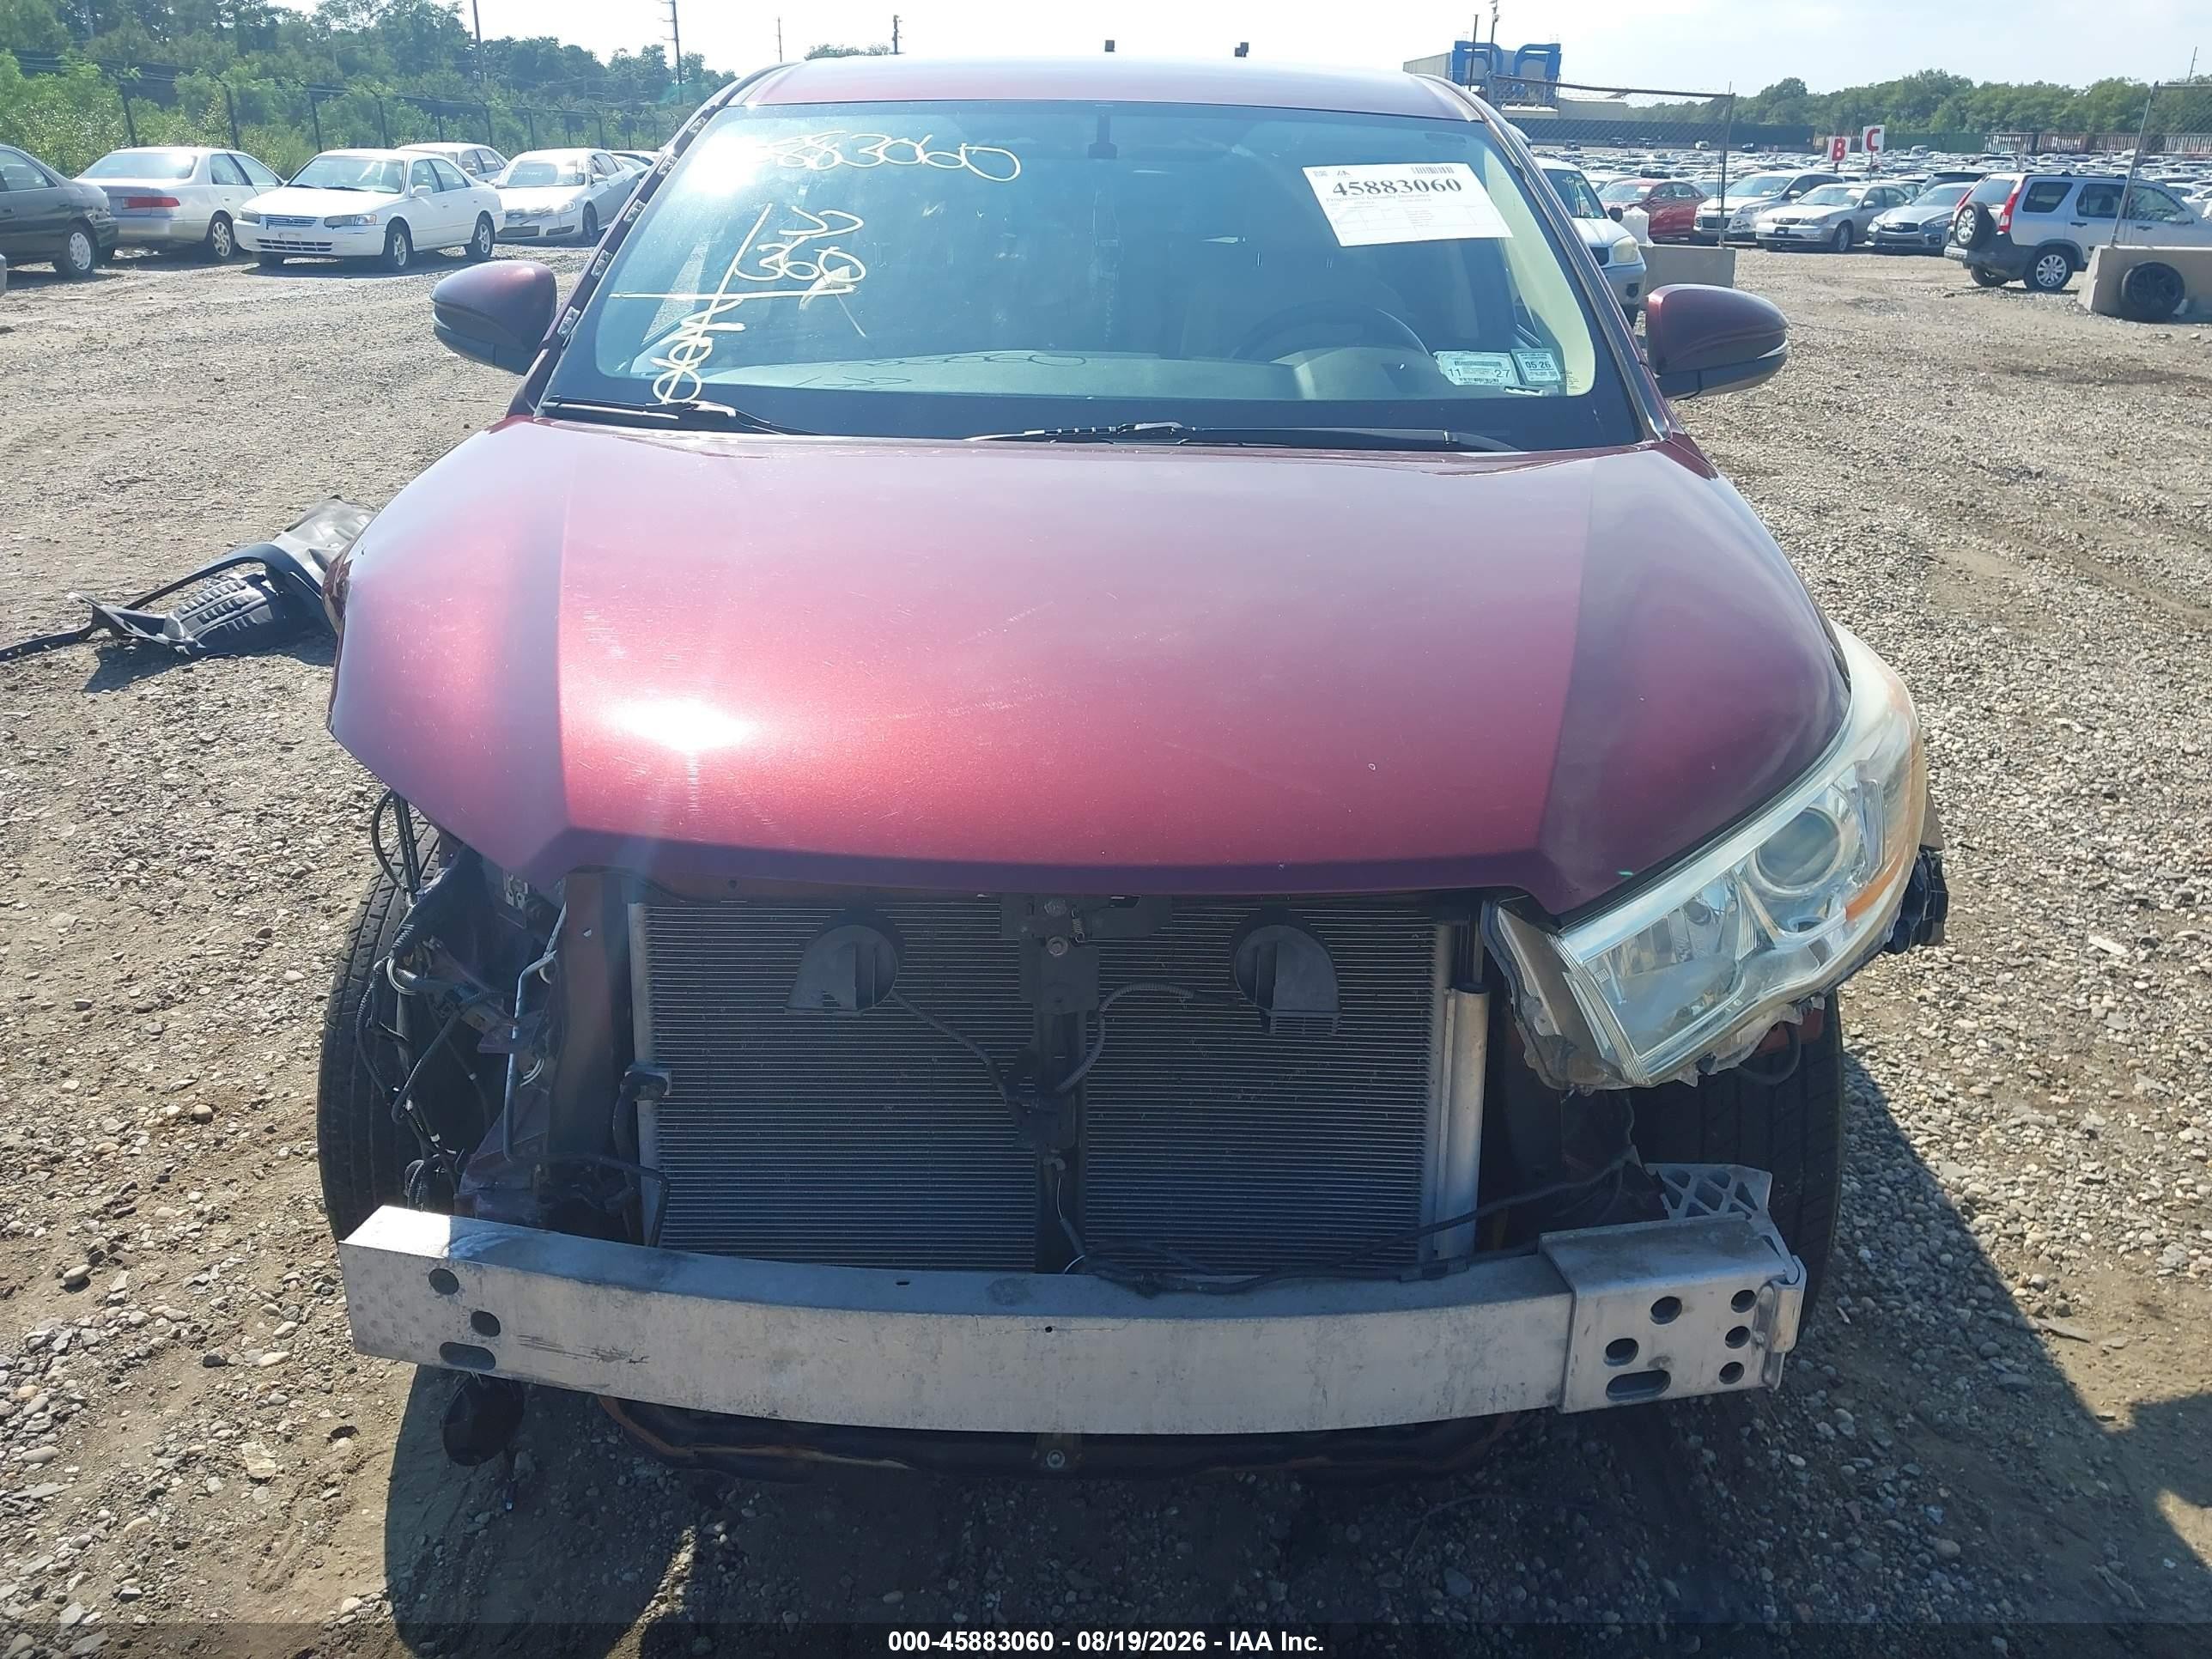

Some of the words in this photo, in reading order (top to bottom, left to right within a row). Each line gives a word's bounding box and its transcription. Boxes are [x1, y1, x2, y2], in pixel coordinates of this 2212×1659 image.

[1832, 137, 1846, 161] B
[1867, 128, 1881, 152] C
[1333, 178, 1462, 197] 45883060
[1447, 368, 1462, 378] 11
[1494, 368, 1510, 378] 27
[1524, 361, 1538, 369] 05
[1538, 361, 1552, 369] 26
